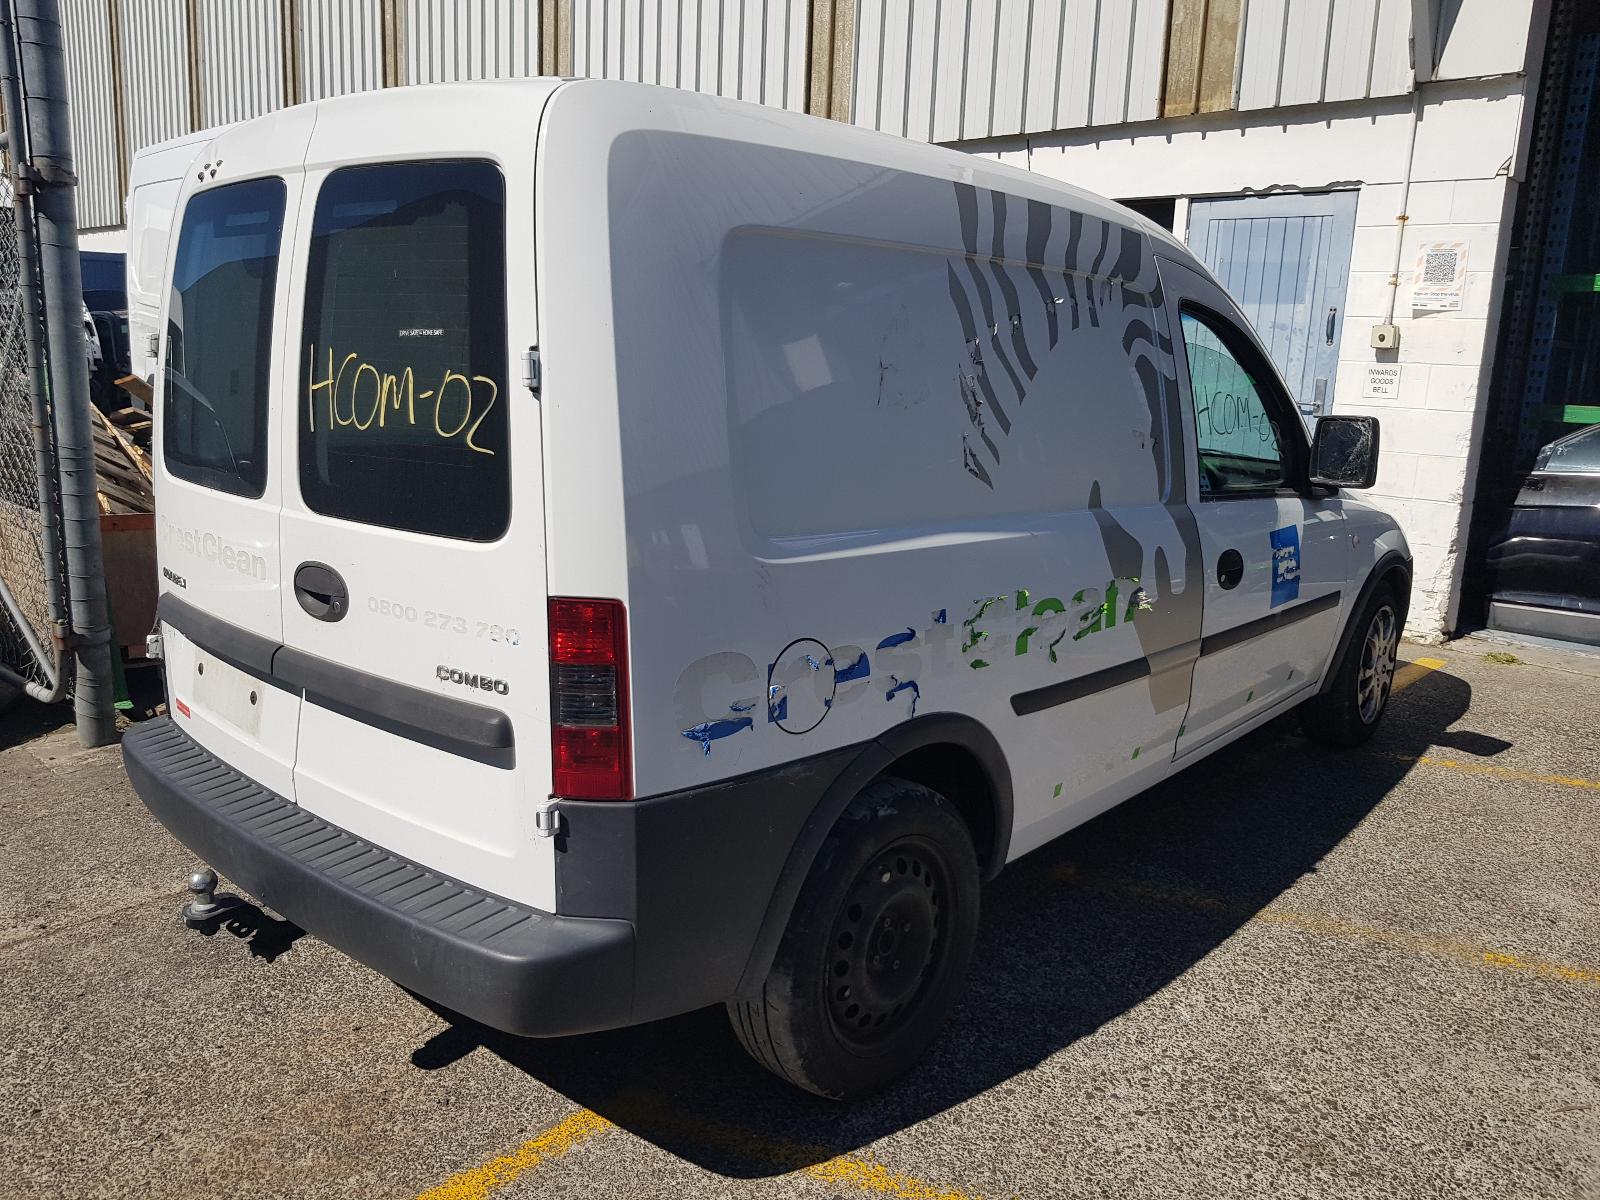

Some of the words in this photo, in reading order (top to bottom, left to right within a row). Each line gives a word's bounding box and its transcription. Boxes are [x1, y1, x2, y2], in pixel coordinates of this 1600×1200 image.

[1368, 369, 1398, 377] INWARDS
[1370, 377, 1394, 385] GOODS
[310, 343, 498, 455] HCOM-02
[1372, 386, 1389, 394] BELL
[367, 596, 418, 623] 0800
[423, 610, 468, 634] 273
[436, 664, 510, 696] COMBO
